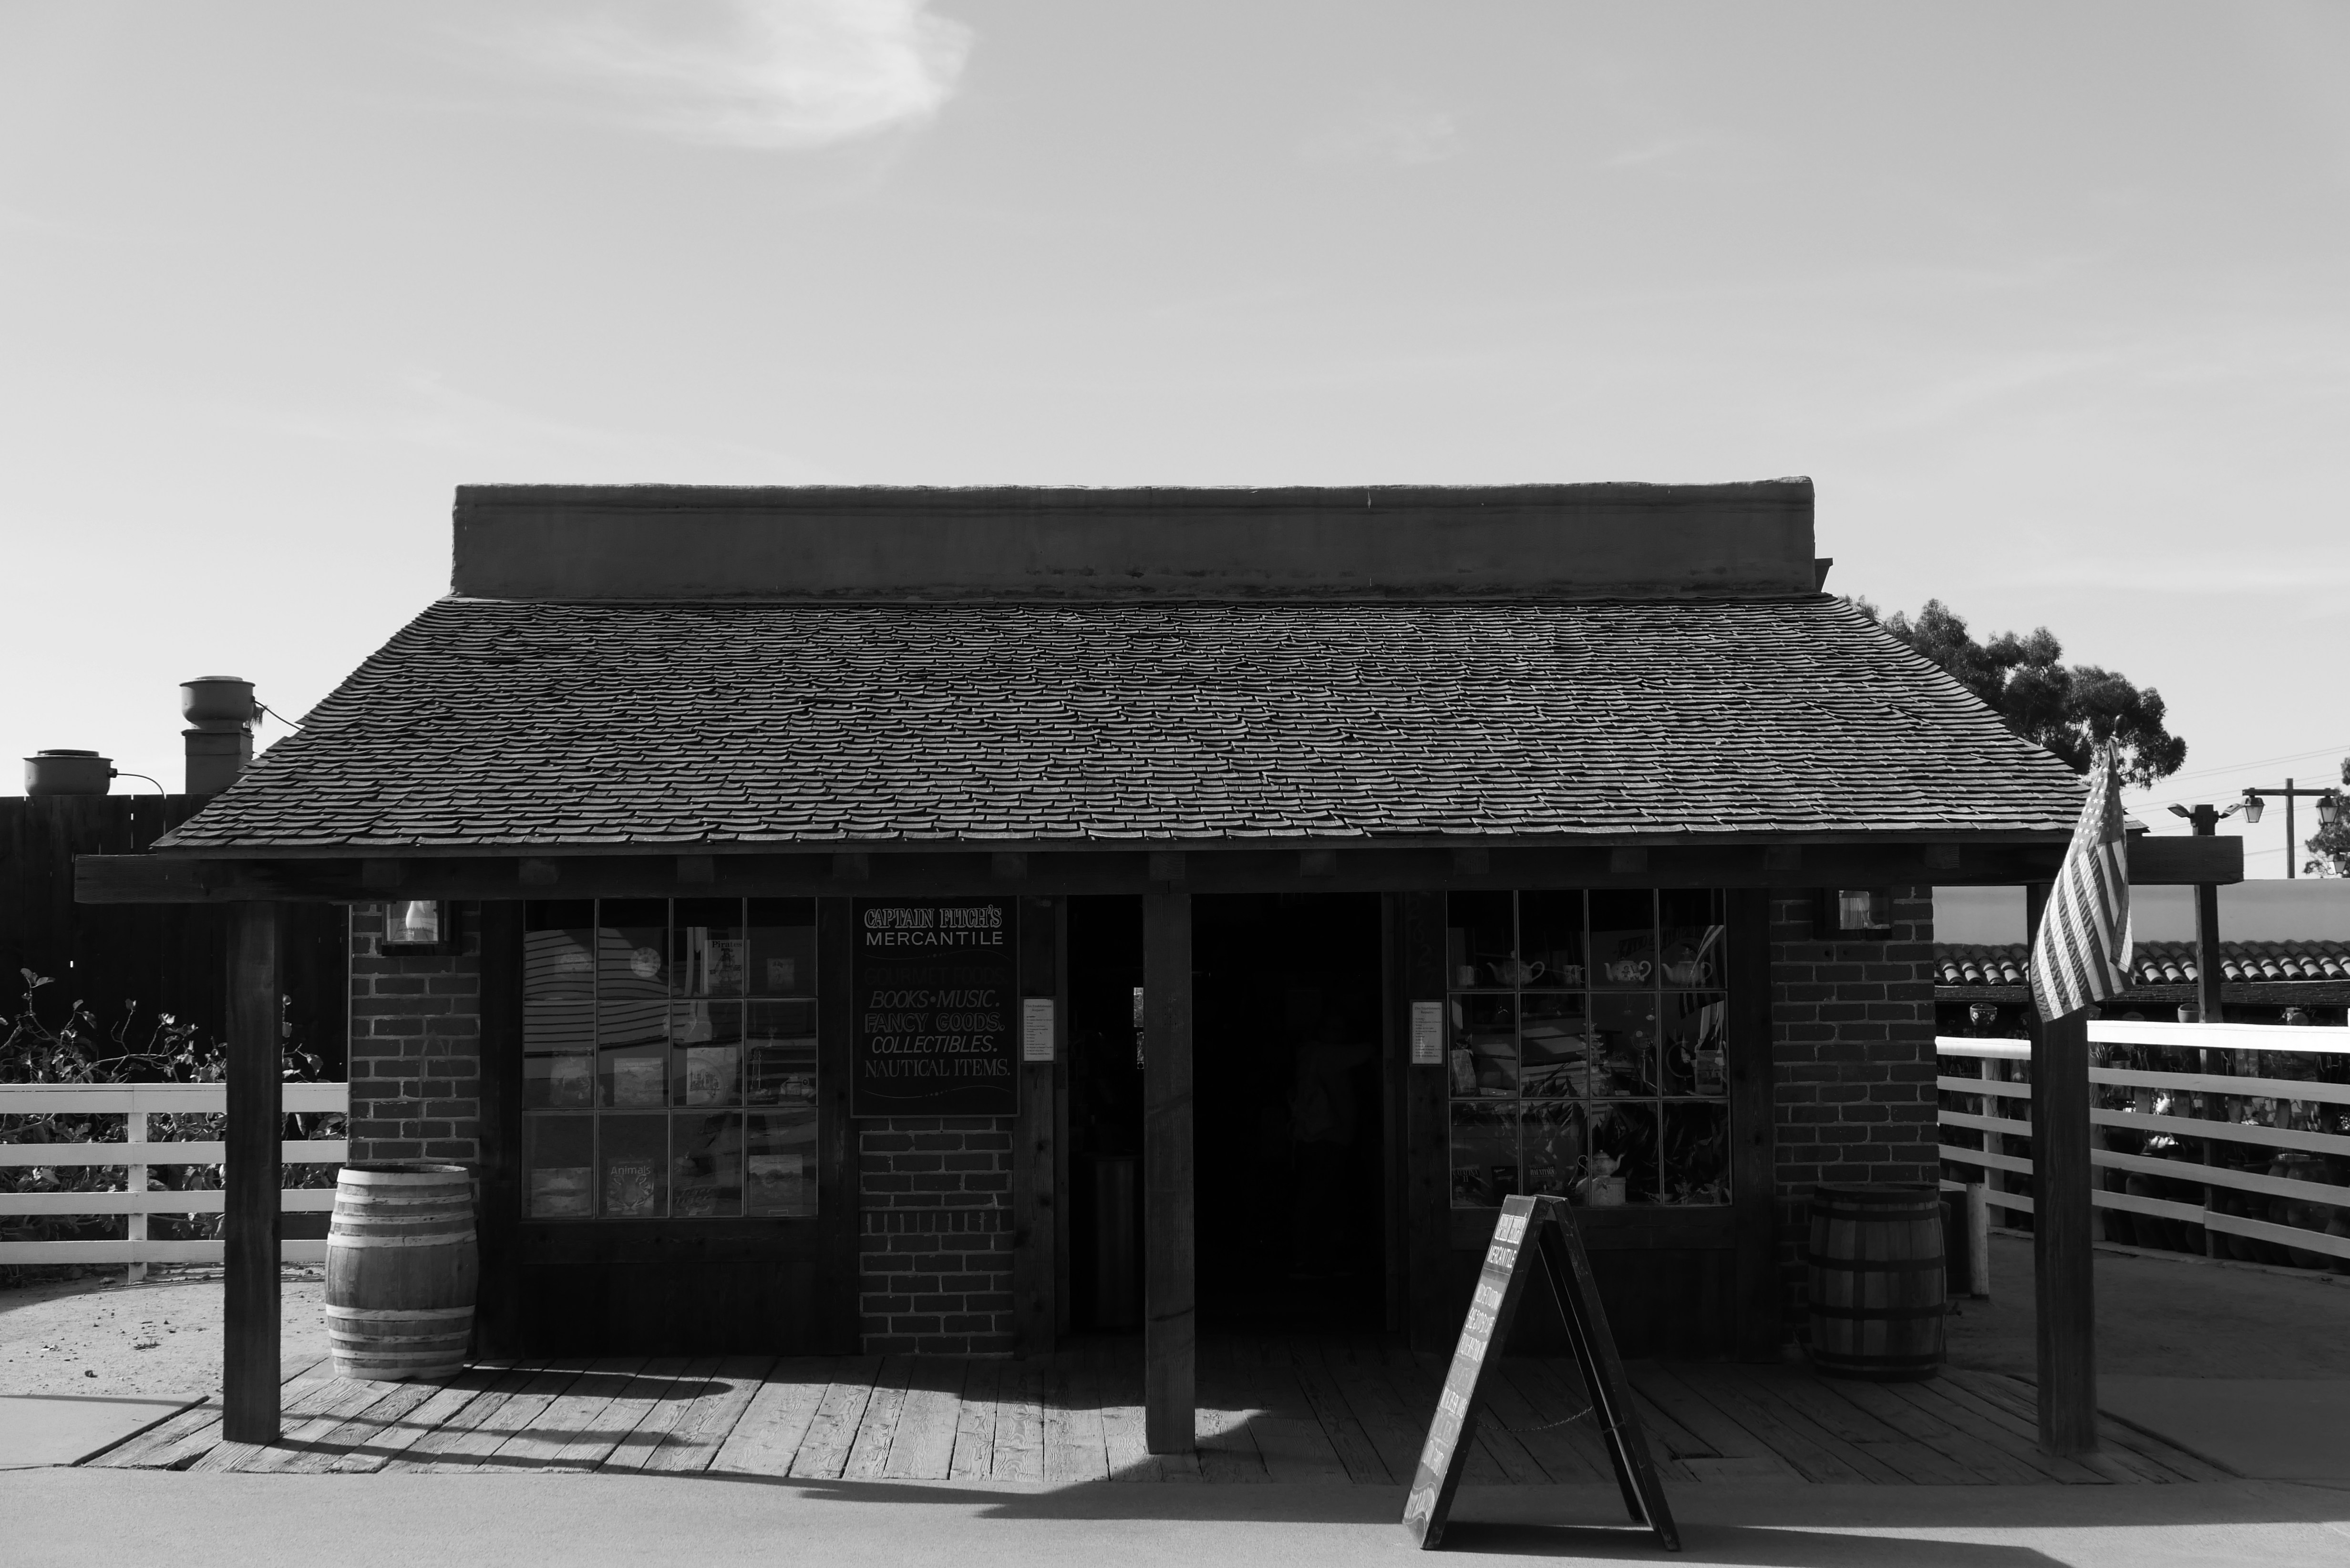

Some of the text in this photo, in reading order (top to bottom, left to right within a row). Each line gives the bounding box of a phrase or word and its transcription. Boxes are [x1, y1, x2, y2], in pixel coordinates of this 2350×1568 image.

[864, 904, 1002, 928] CAPTAIN FITCH'S
[866, 931, 1003, 946] MERCANTILE
[865, 967, 948, 985] GOURMET
[865, 1011, 1005, 1033] FANCY GOODS.
[872, 1035, 998, 1053] COLLECTIBLES.
[865, 1058, 1011, 1077] NAUTICAL ITEMS.
[611, 1165, 651, 1175] Animals
[1486, 1245, 1517, 1268] MERCANTILE
